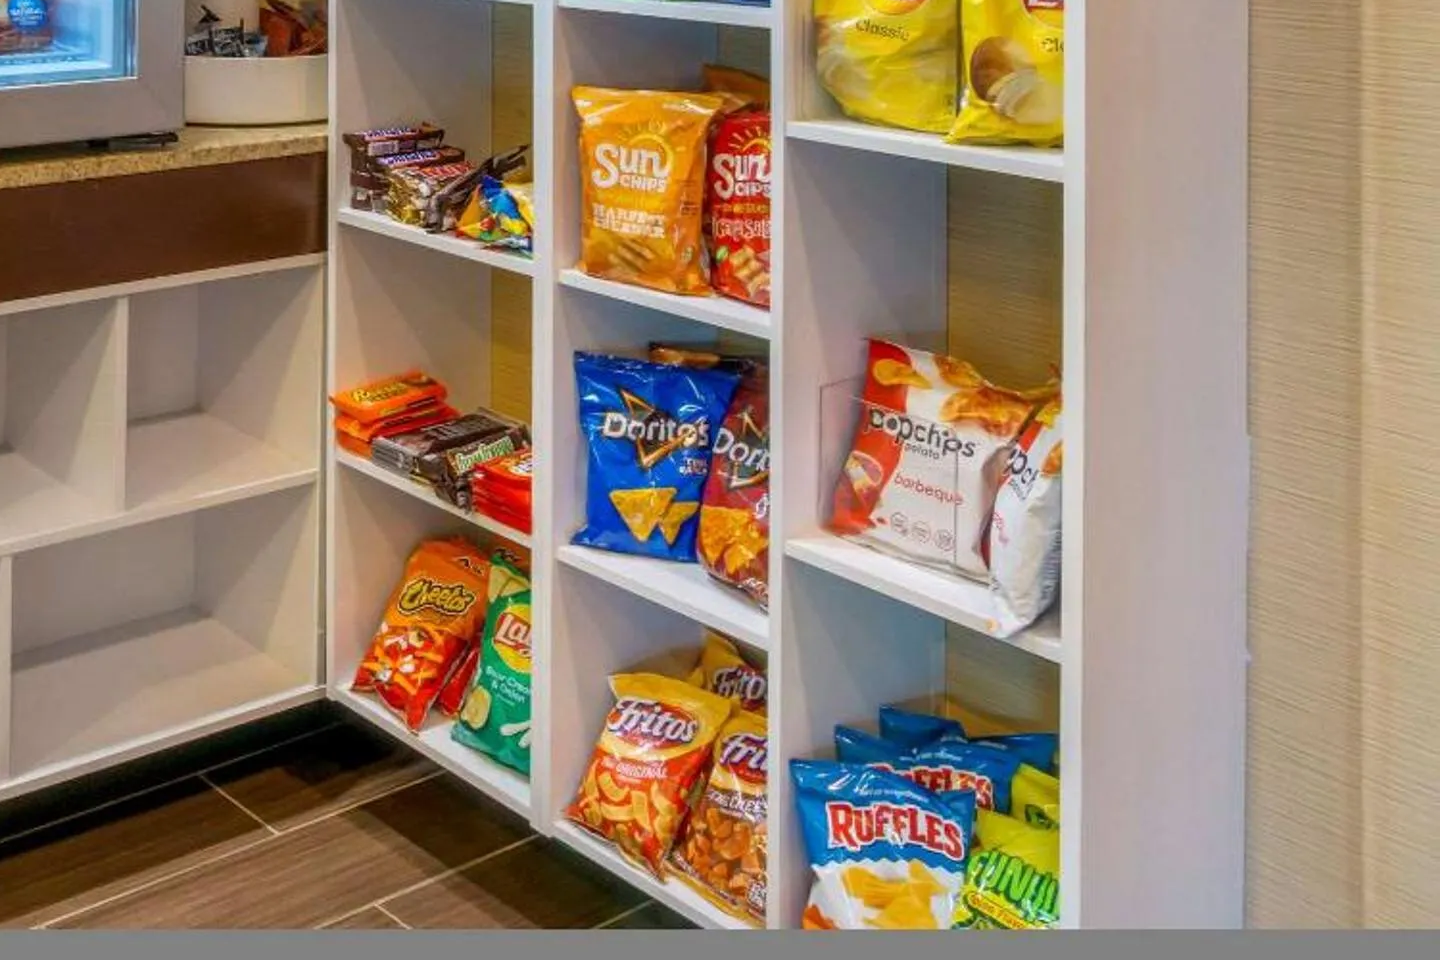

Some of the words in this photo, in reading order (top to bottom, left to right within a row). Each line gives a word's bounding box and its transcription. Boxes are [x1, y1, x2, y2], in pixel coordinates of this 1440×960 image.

[856, 18, 910, 41] Classic
[590, 143, 671, 190] Sun
[619, 174, 668, 193] CHIPS
[712, 152, 771, 200] Sun
[601, 411, 710, 448] Doritos
[868, 408, 976, 458] popchips
[893, 472, 964, 506] barbeque
[399, 578, 473, 612] Cheetos
[714, 666, 767, 701] Frito
[607, 695, 698, 742] Fritos
[720, 733, 768, 769] Frit
[826, 801, 964, 861] RUFFLES
